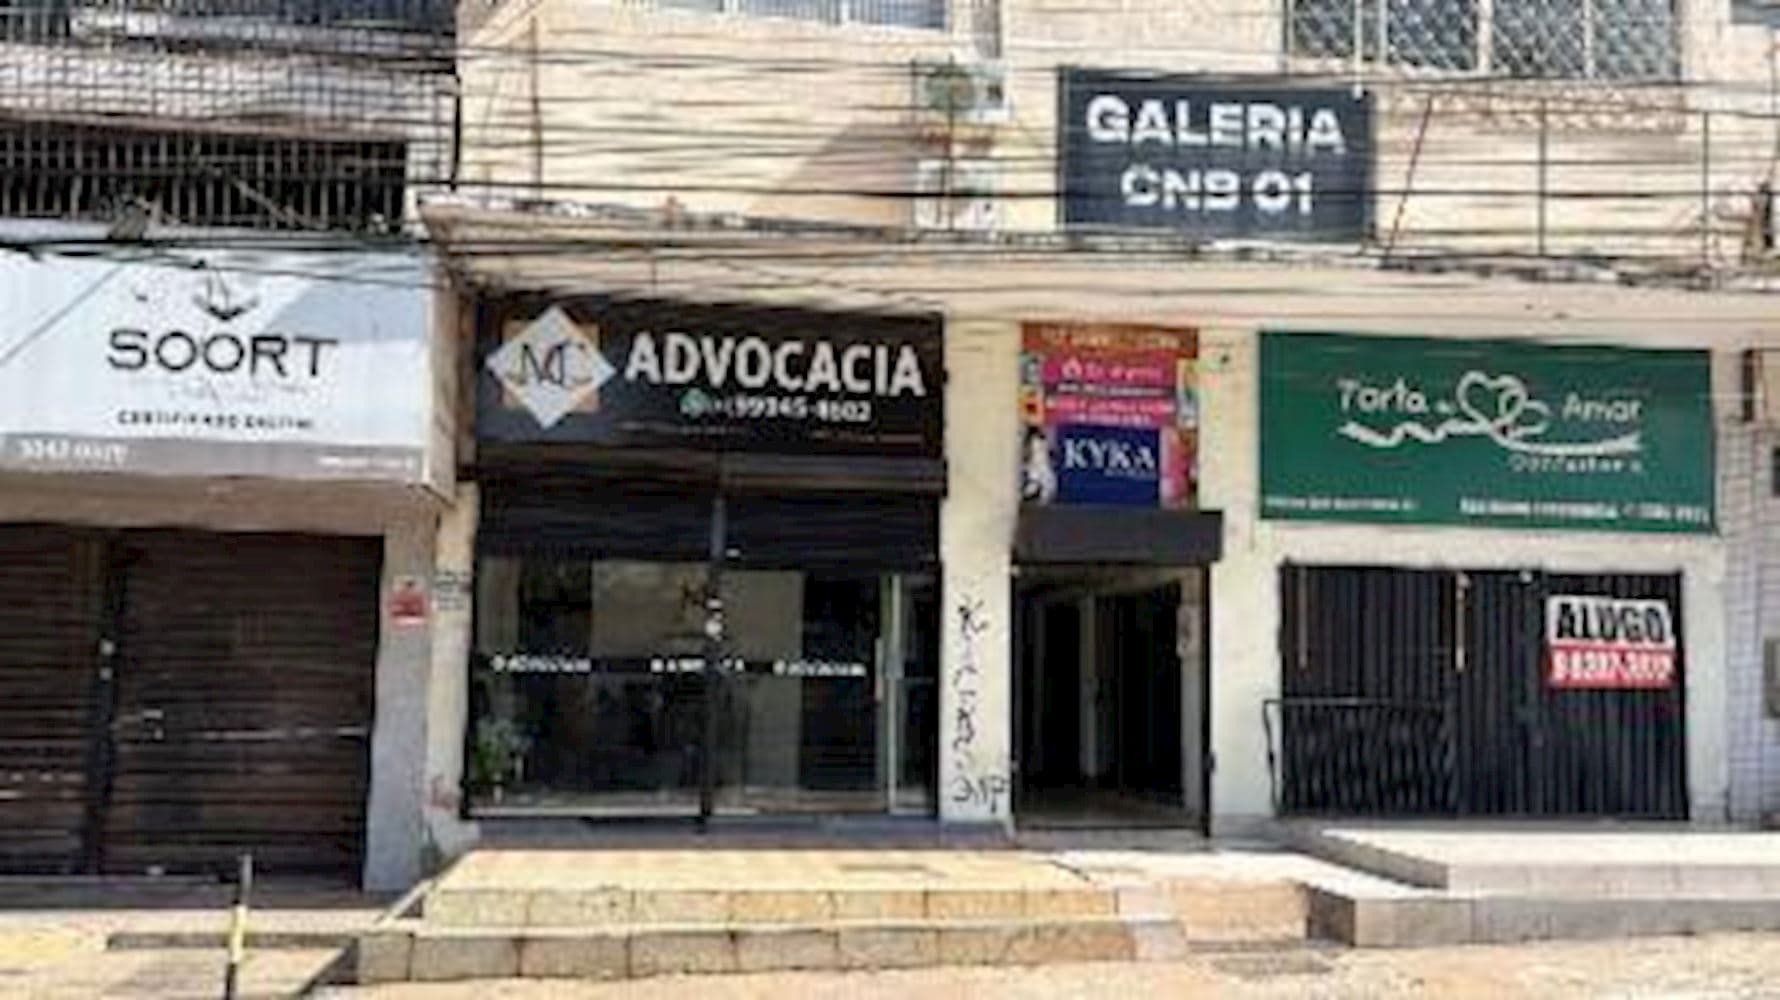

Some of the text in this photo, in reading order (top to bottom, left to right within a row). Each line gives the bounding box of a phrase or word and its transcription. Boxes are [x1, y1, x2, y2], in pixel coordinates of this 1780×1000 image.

[1086, 94, 1347, 154] GALERIA
[107, 330, 339, 377] SOORT
[624, 331, 927, 397] ADVOCACIA
[1062, 437, 1156, 469] KYKA
[1556, 602, 1667, 644] ALUGO
